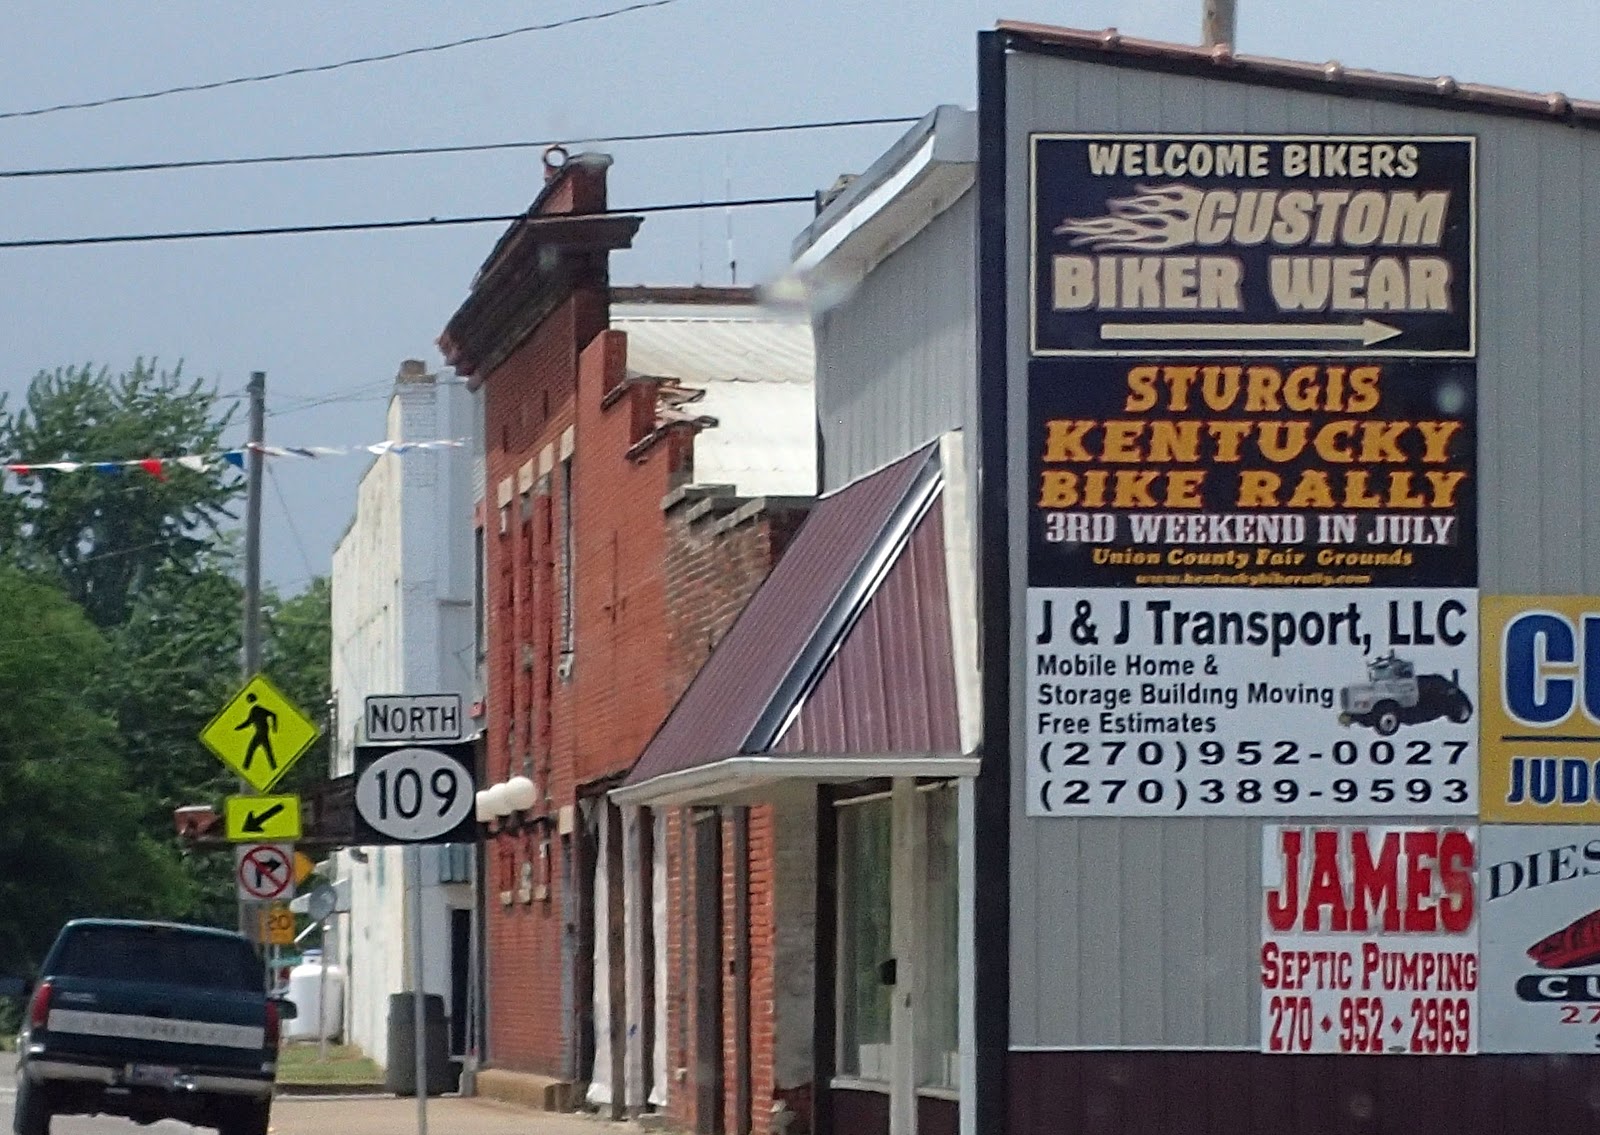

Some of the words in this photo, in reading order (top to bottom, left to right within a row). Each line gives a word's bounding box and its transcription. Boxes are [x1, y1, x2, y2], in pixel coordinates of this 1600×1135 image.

[1088, 143, 1269, 177] WELCOME
[1283, 144, 1419, 179] BIKERS
[1195, 189, 1450, 246] CUSTOM
[1052, 255, 1243, 311] BIKER
[1269, 256, 1451, 312] WEAR
[1124, 366, 1382, 413] STURGIS
[1043, 420, 1461, 463] KENTUCKY
[1038, 469, 1208, 508] BIKE
[1236, 470, 1466, 508] RALLY
[1045, 513, 1116, 544] 3RD
[1127, 514, 1305, 545] WEEKEND
[1318, 515, 1356, 545] IN
[1366, 515, 1456, 546] JULY
[1092, 548, 1160, 565] Union
[1166, 548, 1251, 569] County
[1255, 549, 1305, 566] Fair
[1317, 548, 1413, 566] Grounds
[1036, 600, 1053, 645] J
[1070, 599, 1099, 645] &
[1114, 601, 1131, 645] J
[1146, 600, 1372, 656] Transport,
[1388, 600, 1467, 646] LLC
[1037, 654, 1117, 676] Mobile
[1125, 655, 1195, 676] Home
[1203, 655, 1219, 675] &
[1038, 684, 1131, 710] Storage
[1141, 684, 1238, 709] Building
[1248, 684, 1334, 708] Moving
[370, 704, 457, 733] NORTH
[1038, 713, 1090, 734] Free
[1100, 713, 1217, 734] Estimates
[1040, 740, 1469, 773] (270)952-0027
[375, 768, 458, 820] 109
[1040, 778, 1469, 811] (270)389-9593
[1506, 757, 1600, 807] JUD
[1266, 828, 1475, 933] JAMES
[268, 914, 292, 931] 20
[1261, 941, 1353, 990] SEPTIC
[1362, 942, 1478, 992] PUMPING
[1269, 996, 1313, 1052] 270
[1339, 997, 1384, 1052] 952
[1409, 998, 1471, 1053] 2969
